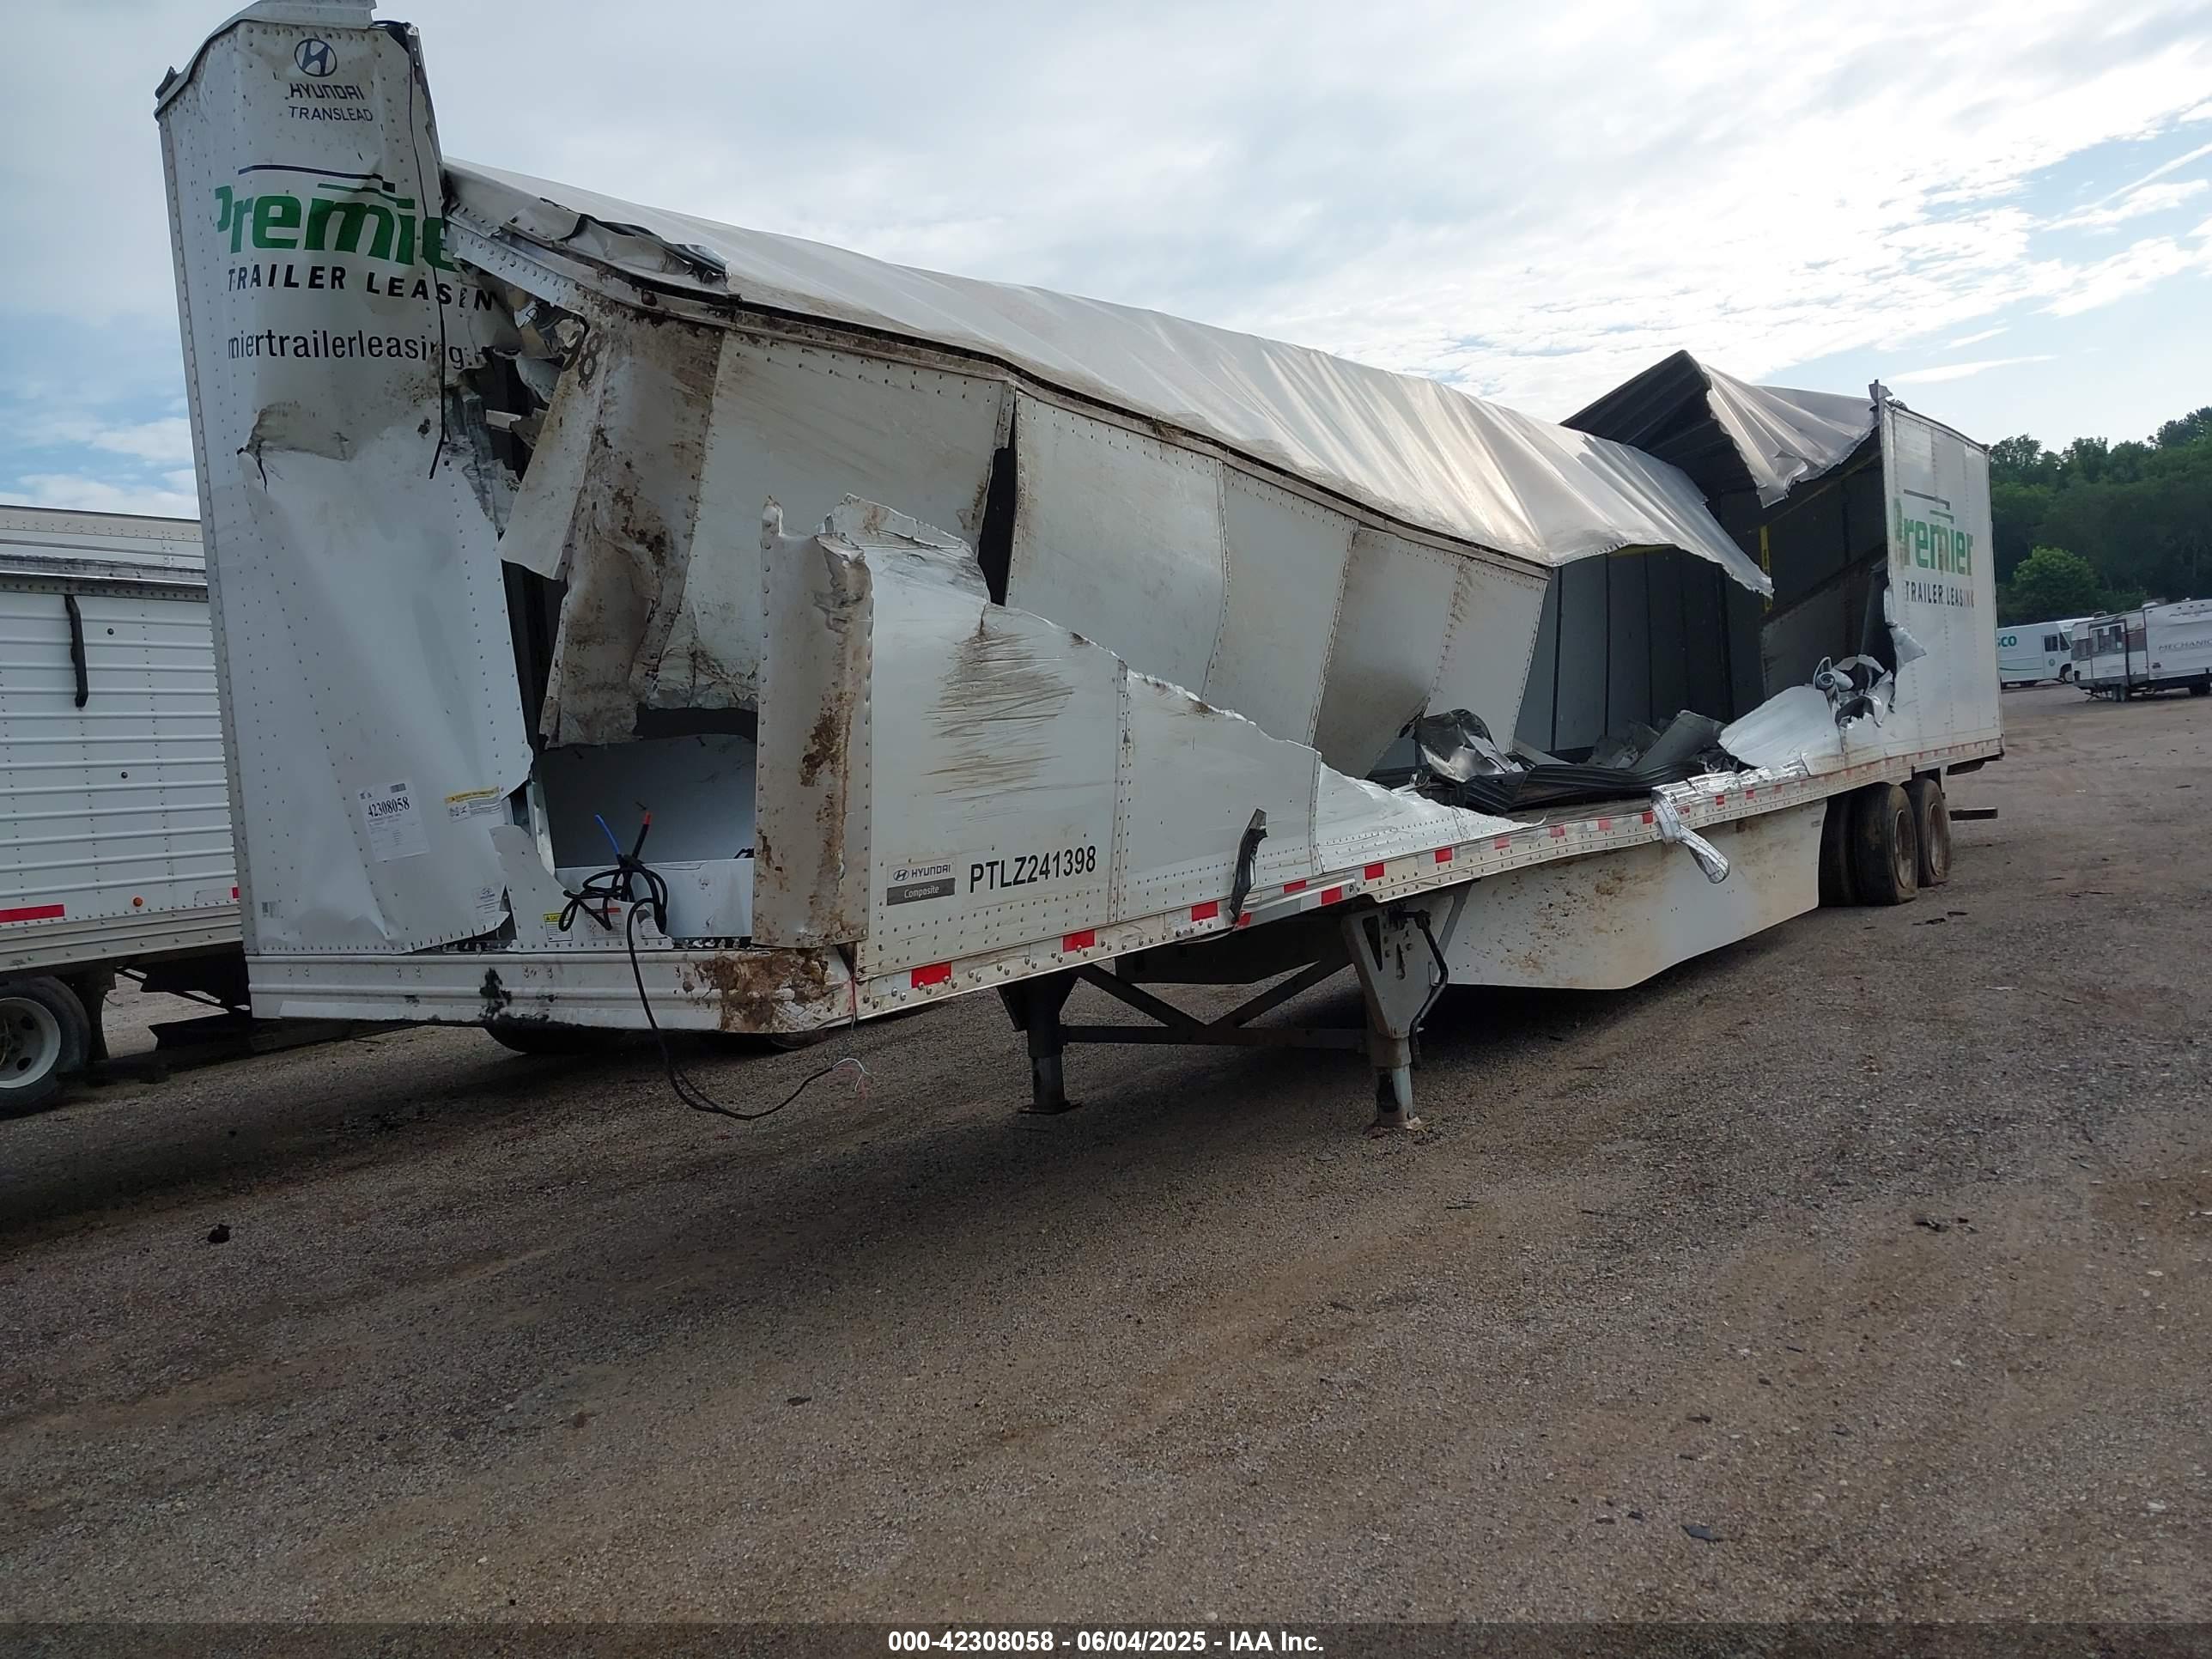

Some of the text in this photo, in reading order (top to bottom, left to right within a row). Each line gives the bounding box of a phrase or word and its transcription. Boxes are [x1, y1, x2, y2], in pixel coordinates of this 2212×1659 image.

[289, 82, 366, 100] HYUNDAI
[289, 106, 374, 123] TRANSLEAD
[228, 264, 347, 292] TRAILER
[1893, 498, 1973, 576] Premier
[1905, 580, 1944, 605] TRAILER
[368, 795, 410, 818] 42308058
[911, 864, 951, 878] HYUNDAI
[969, 845, 1097, 894] PTLZ241398
[904, 884, 939, 899] Composite
